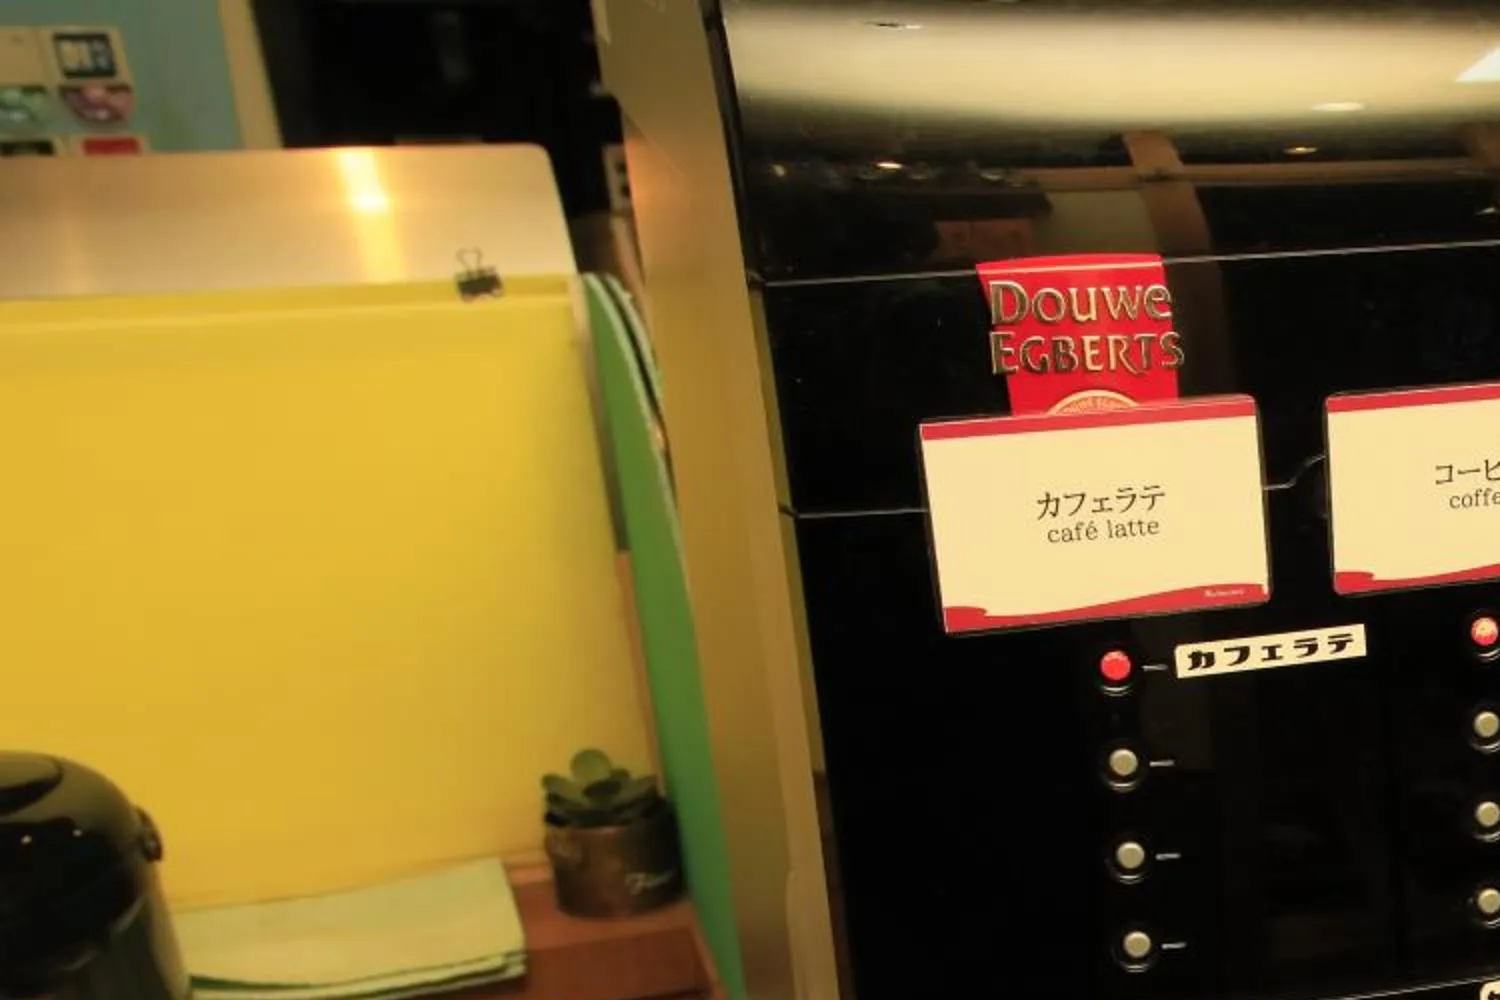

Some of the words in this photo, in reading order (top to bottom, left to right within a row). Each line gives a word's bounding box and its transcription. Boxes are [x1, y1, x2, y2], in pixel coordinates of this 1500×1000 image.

[988, 330, 1185, 375] EGBERTS
[1036, 484, 1166, 521] カフェラテ
[1047, 517, 1100, 543] café
[1106, 517, 1161, 539] latte
[1187, 633, 1354, 671] カフェラテ
